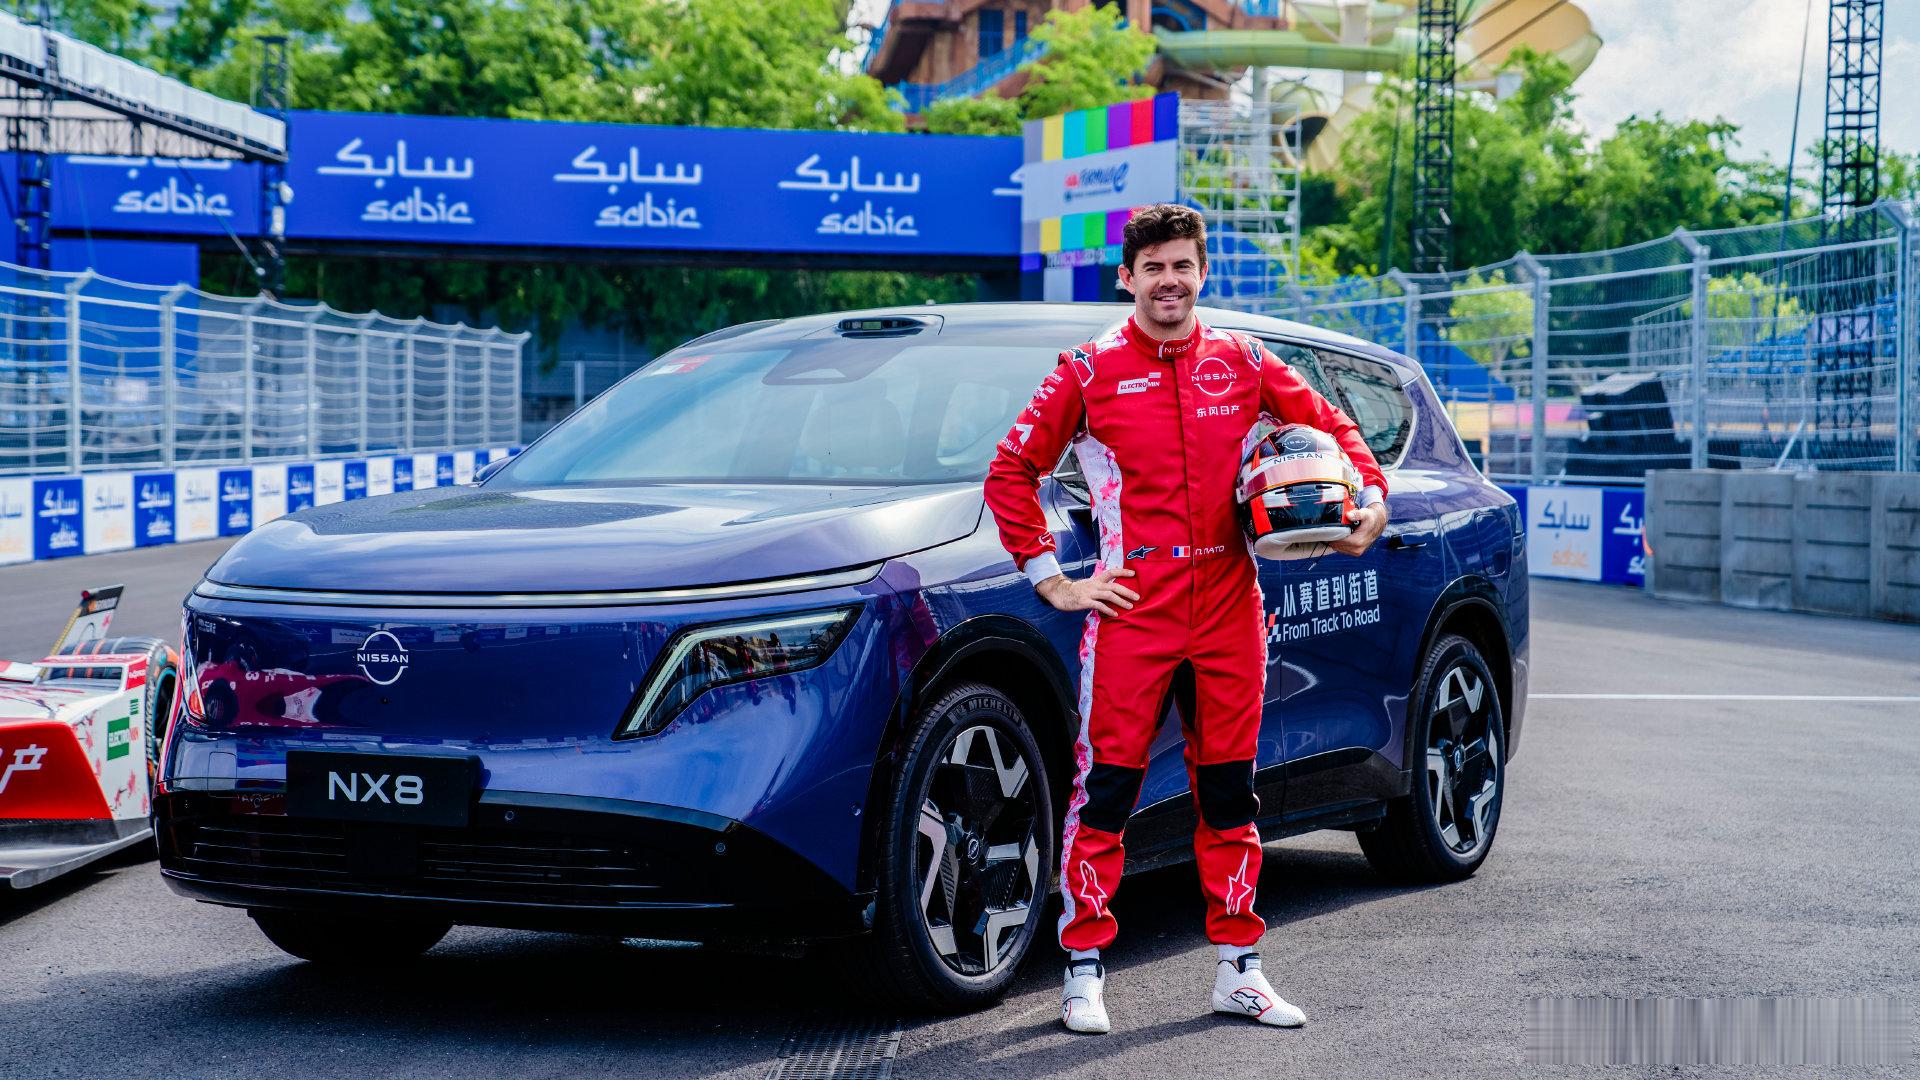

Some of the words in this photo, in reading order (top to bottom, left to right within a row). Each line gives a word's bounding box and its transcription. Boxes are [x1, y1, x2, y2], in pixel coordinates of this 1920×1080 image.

[113, 176, 234, 216] sabic
[361, 186, 475, 223] sabic
[595, 191, 702, 229] sabic
[817, 200, 919, 236] sabic
[1191, 372, 1237, 382] NISSAN
[1196, 404, 1240, 418] 东风日产
[1273, 453, 1323, 465] NISSAN
[1283, 569, 1379, 617] 从赛道到街道
[1283, 622, 1310, 641] From
[1311, 613, 1339, 635] Track
[1340, 611, 1353, 629] To
[1354, 604, 1380, 626] Road
[357, 653, 409, 664] NISSAN
[968, 698, 1021, 723] MICHELIN
[0, 743, 48, 794] 产
[328, 771, 424, 805] NX8
